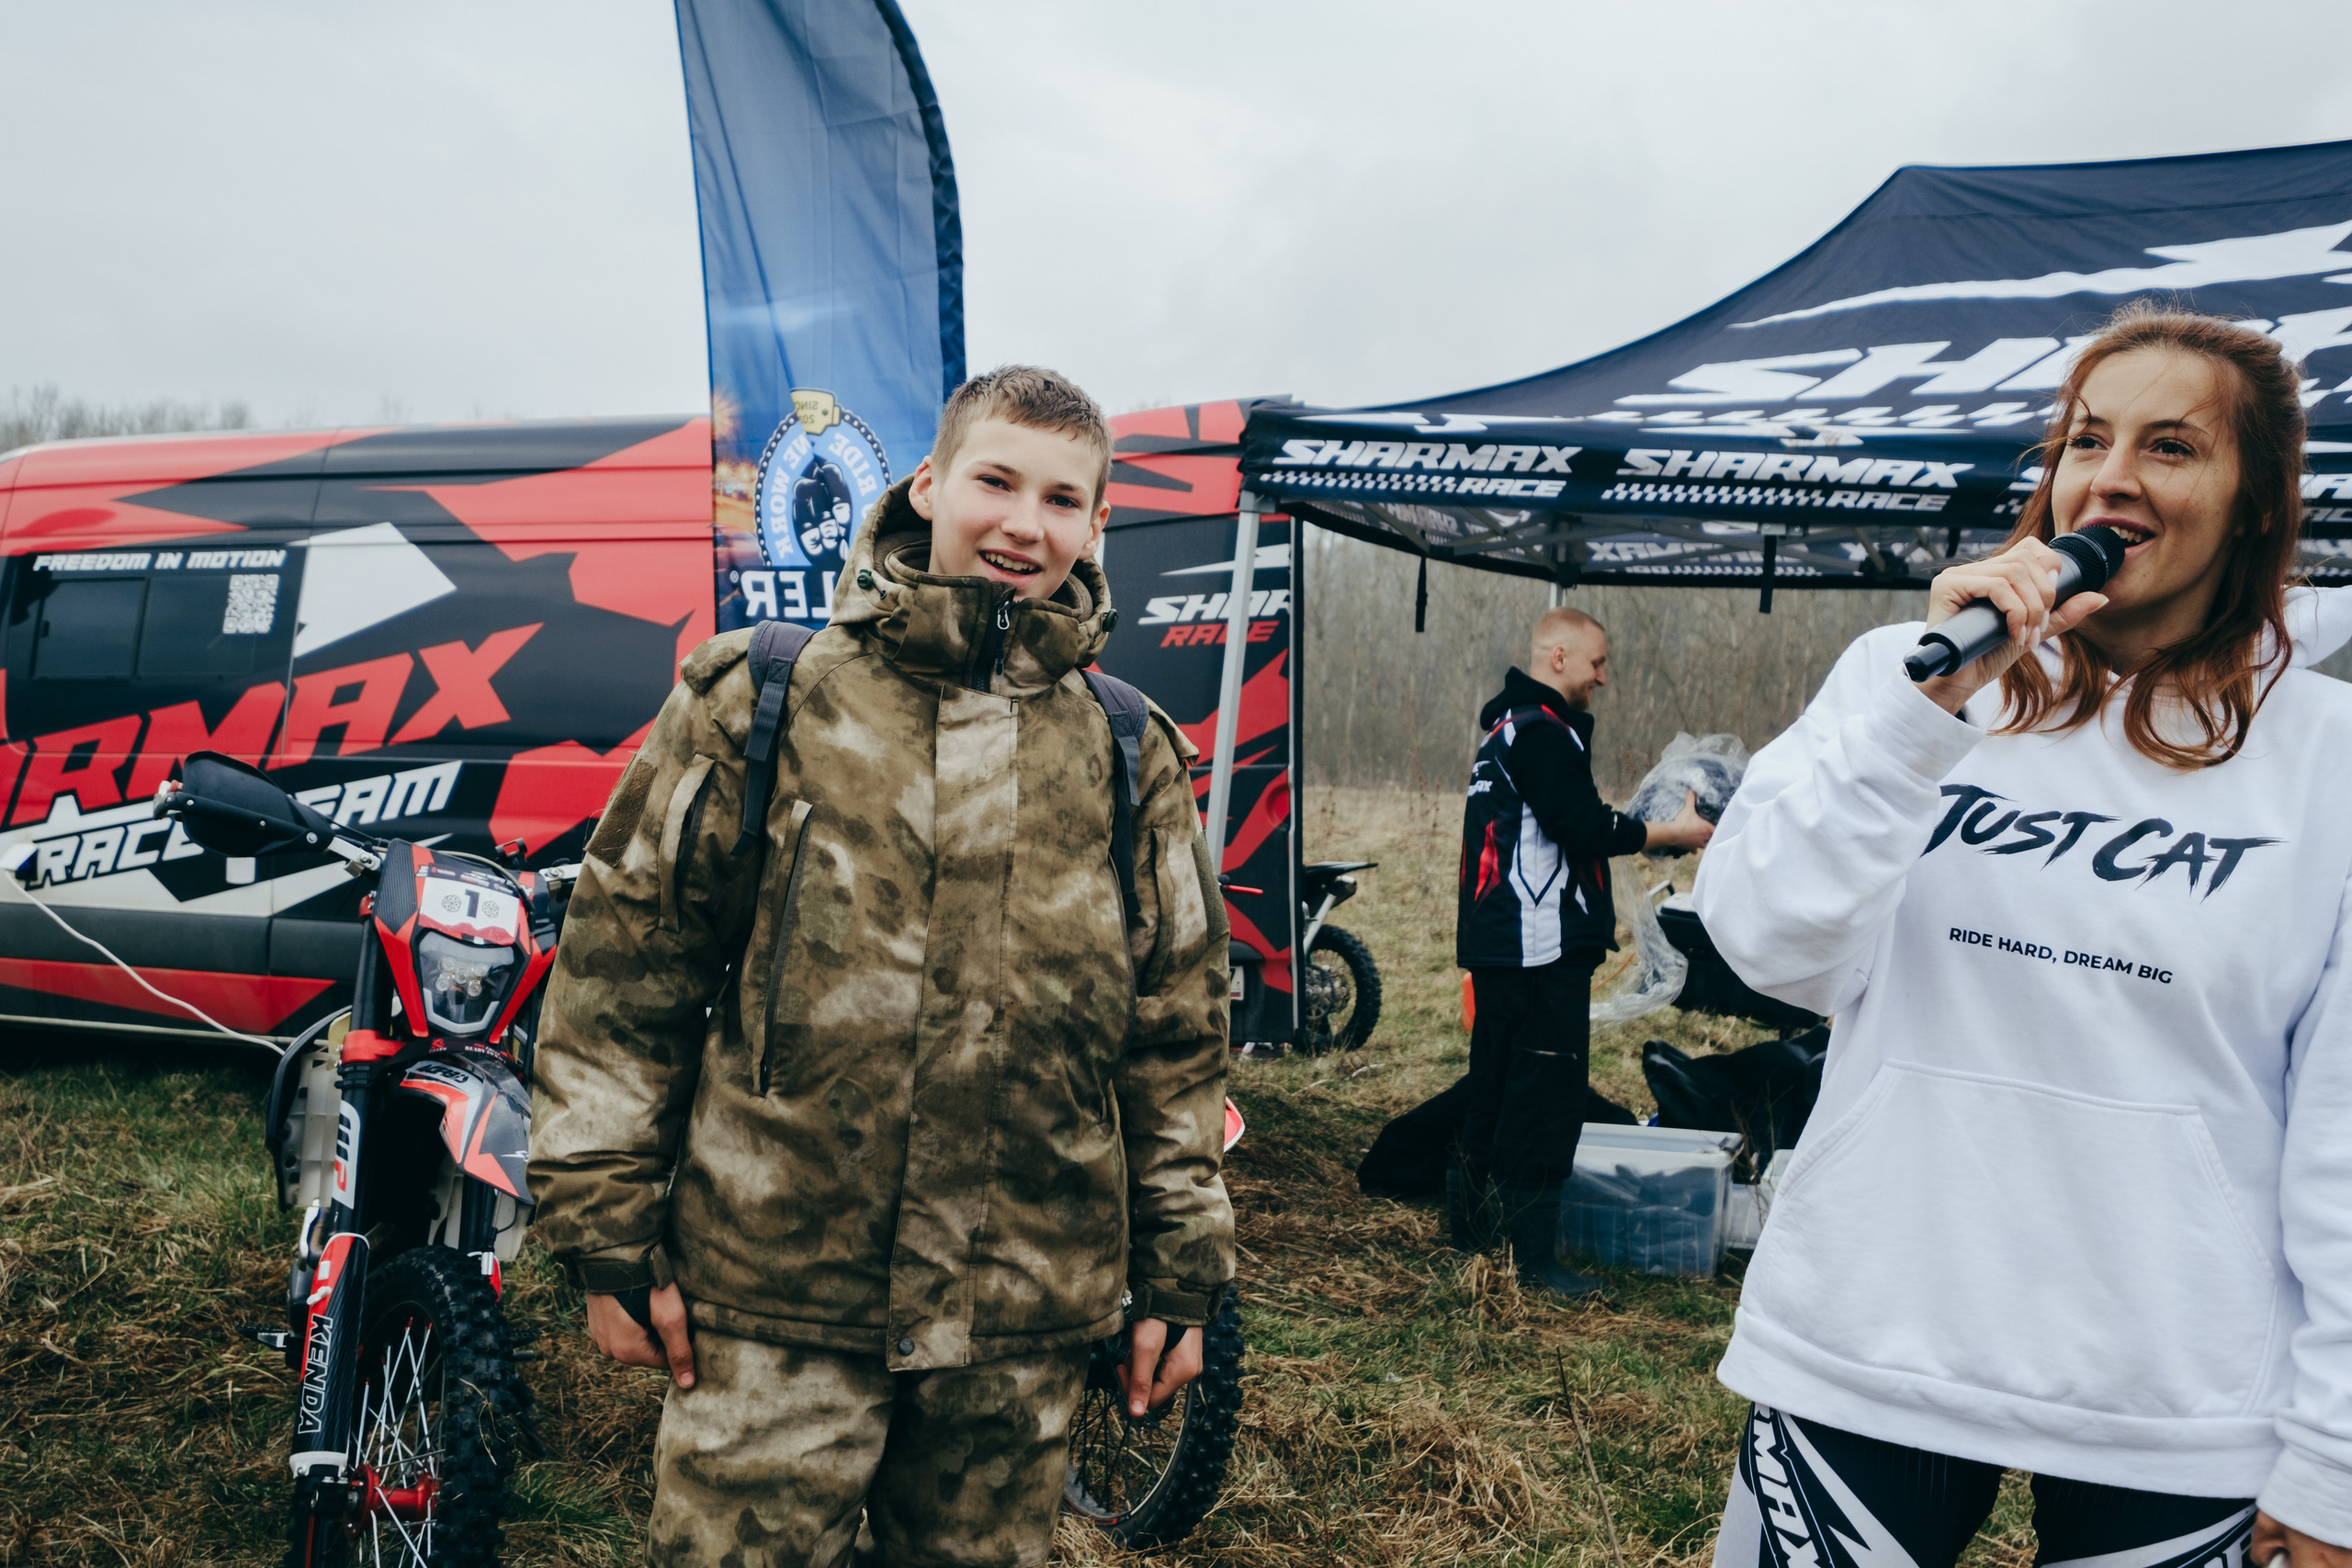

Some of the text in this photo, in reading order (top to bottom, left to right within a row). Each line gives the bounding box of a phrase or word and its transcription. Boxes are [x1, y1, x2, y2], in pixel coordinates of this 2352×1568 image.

[1272, 439, 1584, 474] SHARMAX
[1615, 447, 1975, 489] SHARMAX
[1454, 477, 1567, 498] RACE
[1825, 490, 1951, 512] RACE
[33, 549, 287, 571] FREEDOM IN MOTION
[1159, 620, 1281, 649] RAE
[287, 760, 463, 830] EAM
[1919, 784, 2290, 905] JUST CAT
[465, 888, 481, 919] 1
[1949, 927, 2173, 984] RIDE HARD, DREAM BIG
[298, 1313, 334, 1434] KENDA
